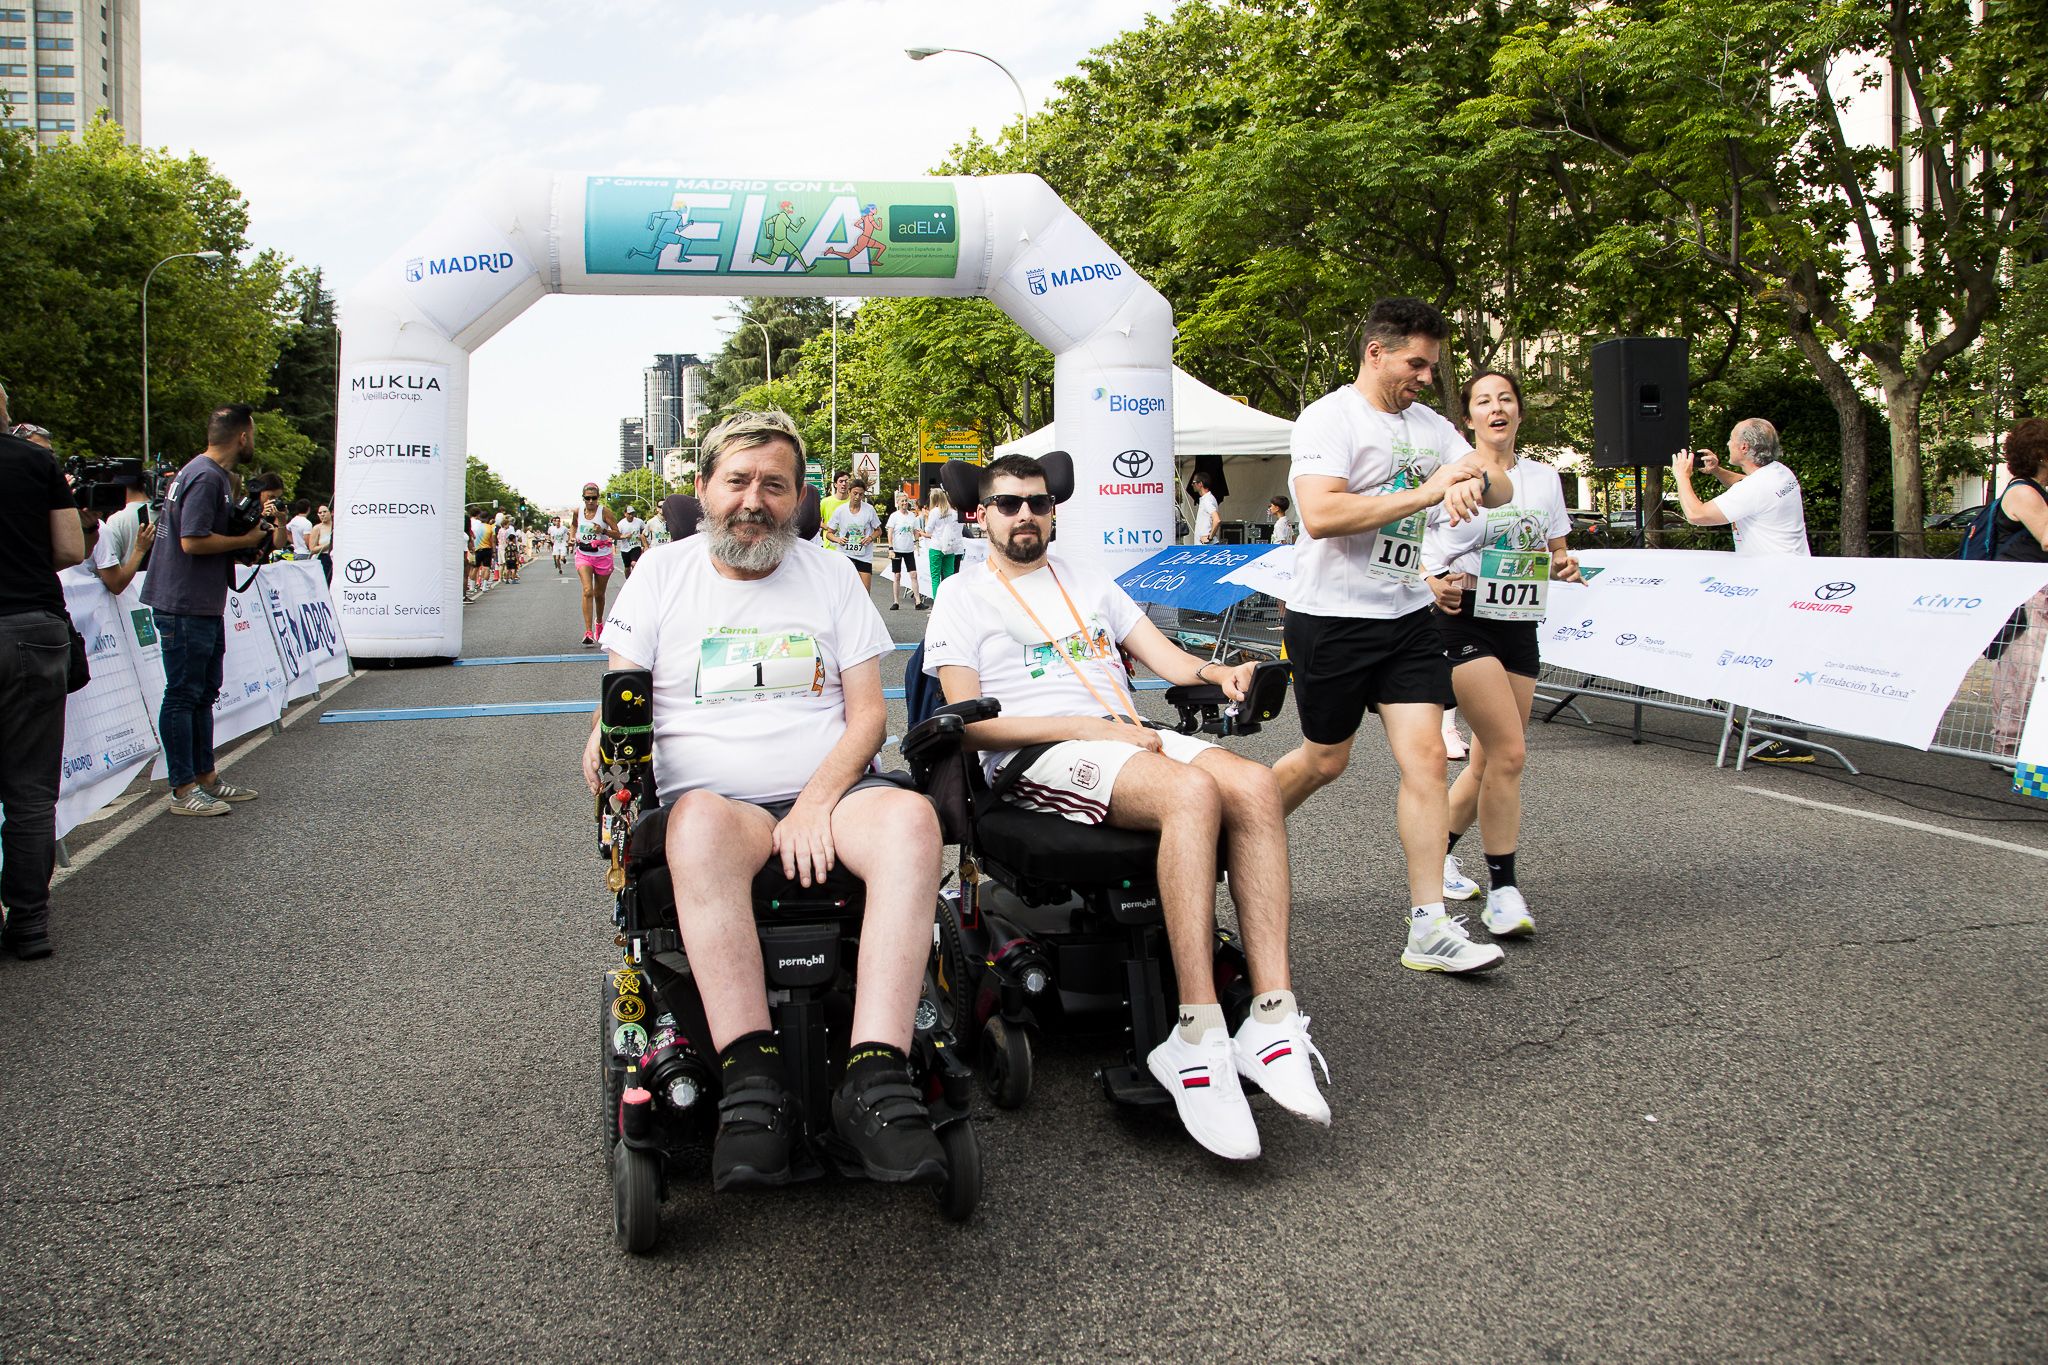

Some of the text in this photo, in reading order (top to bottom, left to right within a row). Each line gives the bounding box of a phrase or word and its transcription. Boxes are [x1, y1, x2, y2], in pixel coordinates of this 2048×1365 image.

[613, 178, 669, 187] Carrera
[675, 179, 768, 191] MADRID
[774, 181, 821, 192] CON
[827, 182, 856, 193] LA
[656, 192, 873, 274] ELA
[898, 221, 946, 234] adELA
[430, 252, 513, 275] MADRID
[1051, 263, 1121, 287] MADRID
[352, 375, 441, 391] MUKUA
[1110, 395, 1165, 415] Biogen
[1139, 569, 1186, 592] Cielo
[343, 590, 377, 603] Toyota
[1485, 582, 1539, 606] 1071
[1705, 581, 1759, 598] Biogen
[343, 604, 441, 616] Financial Services
[719, 626, 758, 635] Carrera
[1557, 626, 1594, 641] amigo
[1733, 655, 1773, 669] MADRID
[752, 662, 765, 687] 1
[1818, 674, 1868, 692] Fundación
[1121, 898, 1156, 911] permobil
[779, 954, 825, 969] permobil
